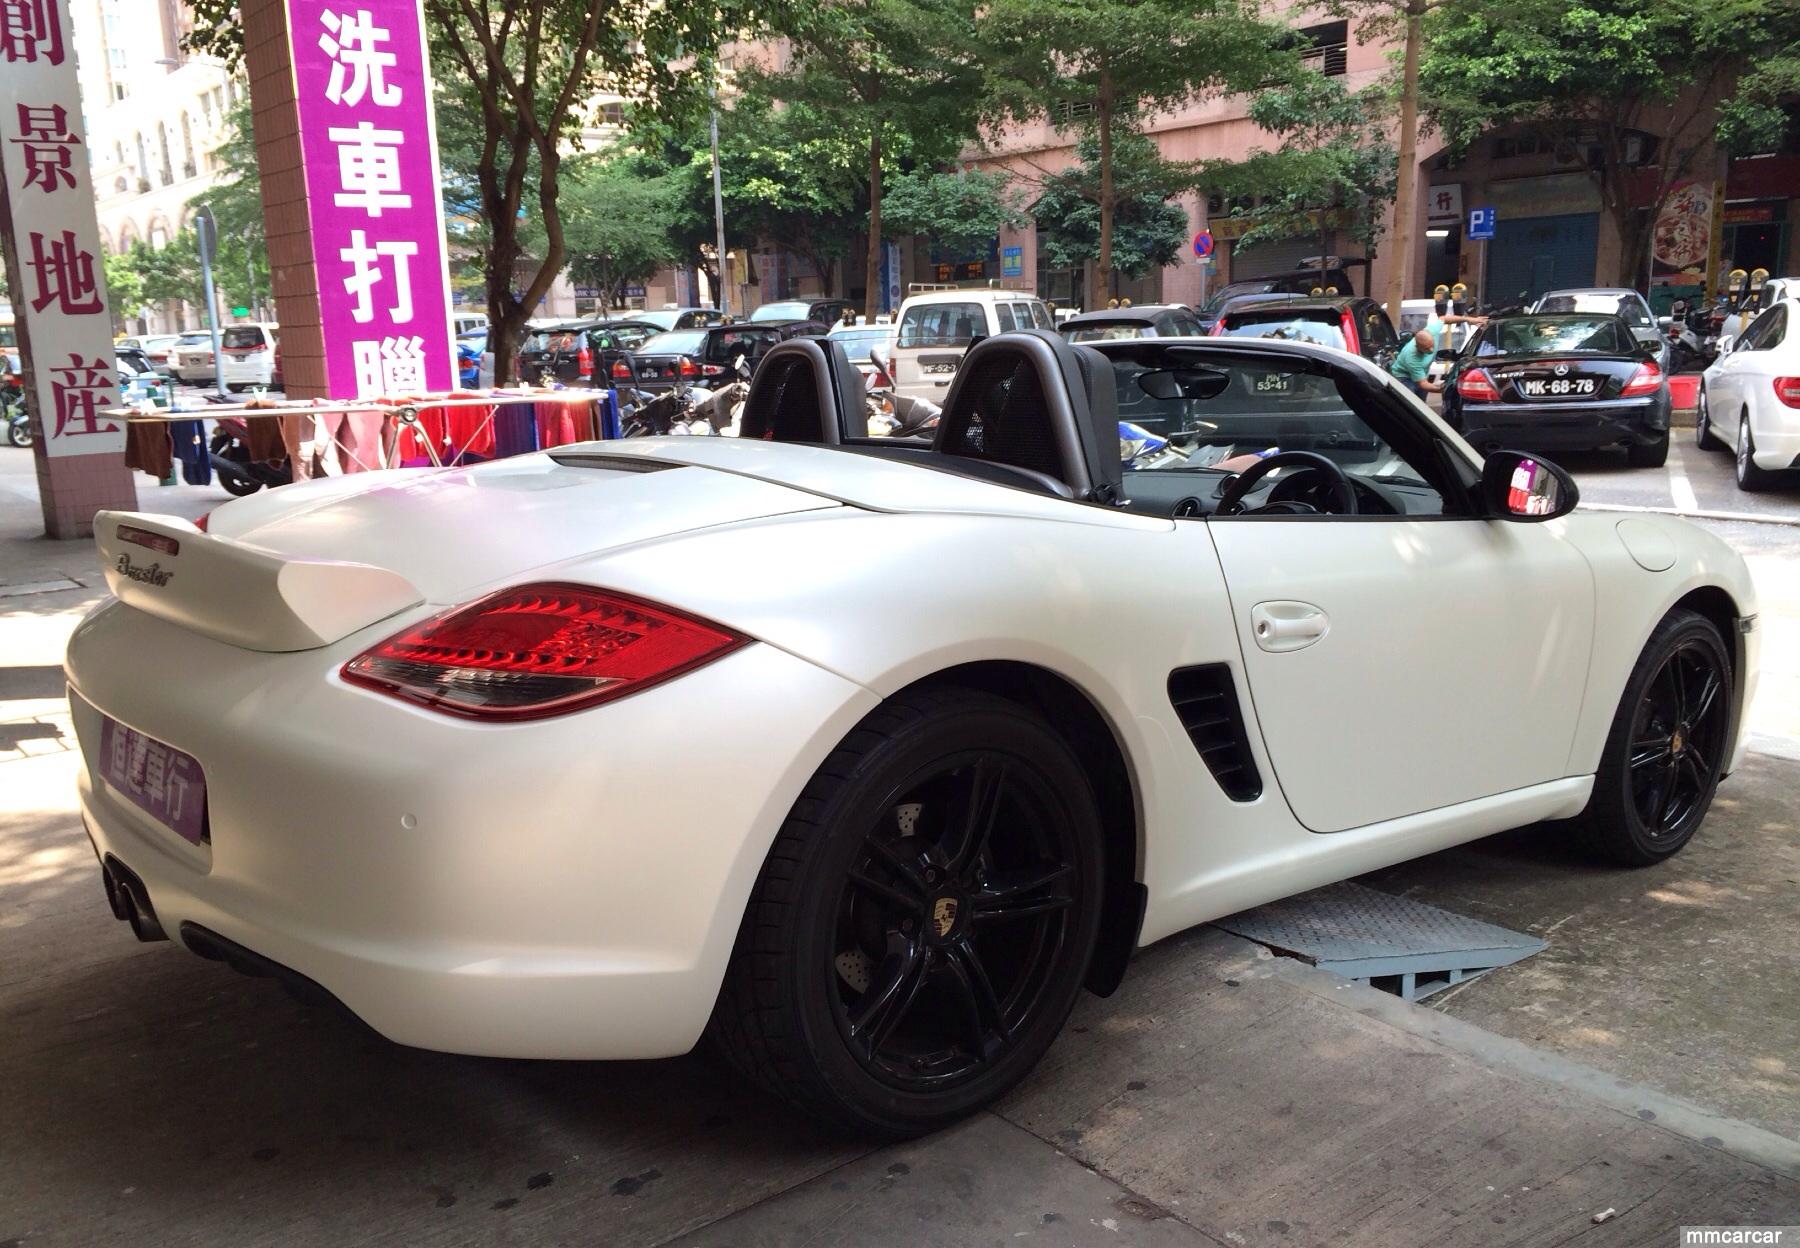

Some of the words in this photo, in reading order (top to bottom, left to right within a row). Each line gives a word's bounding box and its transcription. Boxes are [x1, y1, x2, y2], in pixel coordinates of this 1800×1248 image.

[1470, 210, 1485, 233] P
[1257, 381, 1288, 391] 53-41
[1525, 378, 1595, 395] MK-68-78
